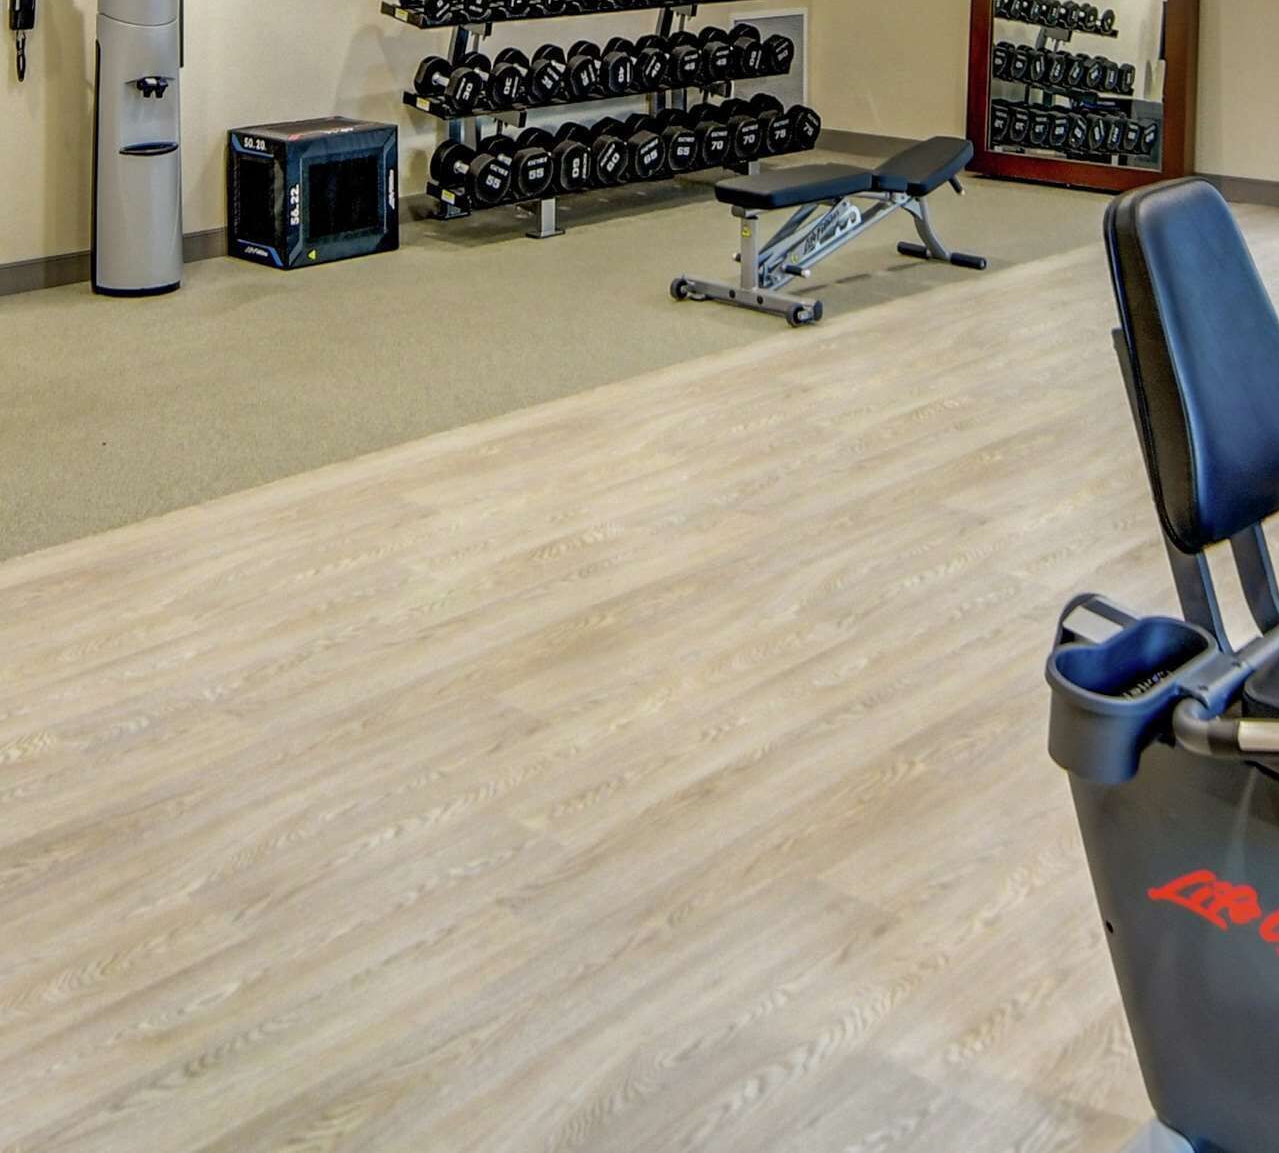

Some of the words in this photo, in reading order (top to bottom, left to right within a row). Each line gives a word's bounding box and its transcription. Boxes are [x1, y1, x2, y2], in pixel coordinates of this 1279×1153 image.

[711, 140, 724, 150] 70
[742, 134, 755, 145] 70
[528, 169, 544, 180] 55
[485, 175, 501, 189] 55
